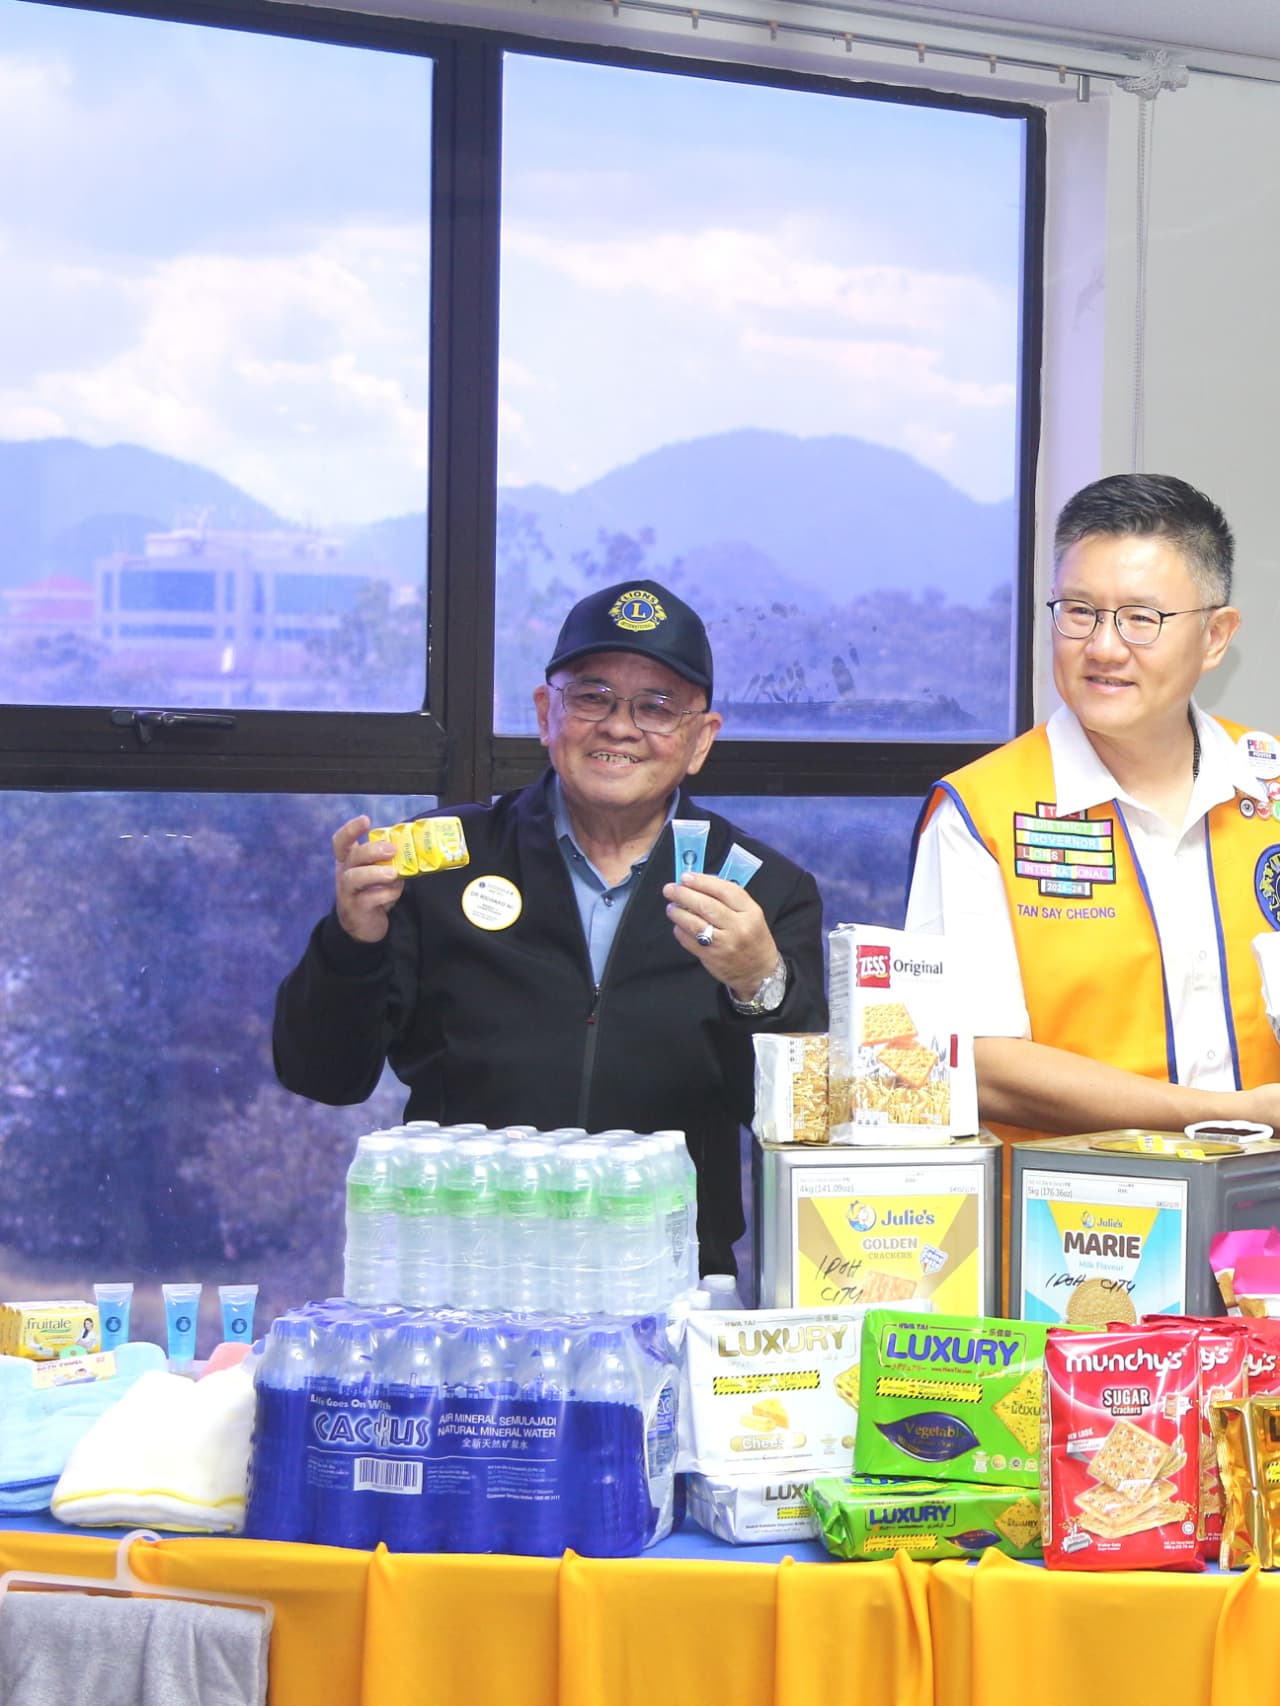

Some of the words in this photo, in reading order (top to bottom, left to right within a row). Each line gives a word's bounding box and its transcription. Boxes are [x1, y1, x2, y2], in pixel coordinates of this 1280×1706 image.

[622, 590, 656, 605] LIONS
[1031, 834, 1097, 848] GOVERNOR
[1017, 903, 1039, 917] TAN
[1042, 905, 1062, 918] SAY
[1066, 907, 1116, 920] CHEONG
[859, 955, 888, 977] ZESS
[893, 959, 944, 976] Original
[881, 1210, 935, 1226] Julie's
[1097, 1217, 1123, 1228] Julie's
[862, 1237, 918, 1250] GOLDEN
[1064, 1231, 1141, 1259] MARIE
[867, 1252, 913, 1260] CRACKERS
[26, 1317, 72, 1331] fruitale
[718, 1324, 848, 1358] LUXURY
[886, 1332, 1020, 1367] LUXURY
[1066, 1349, 1183, 1379] munchy's
[326, 1397, 349, 1408] Goes
[351, 1398, 366, 1409] On
[368, 1399, 392, 1411] With
[1103, 1388, 1150, 1406] SUGAR
[1111, 1405, 1142, 1415] Crackers
[439, 1412, 454, 1424] AIR
[454, 1413, 497, 1425] MINERAL
[499, 1415, 557, 1427] SEMULAJADI
[438, 1424, 479, 1436] NATURAL
[480, 1426, 522, 1438] MINERAL
[524, 1428, 556, 1439] WATER
[904, 1422, 962, 1438] Vegetabl
[869, 1503, 952, 1525] LUXURY
